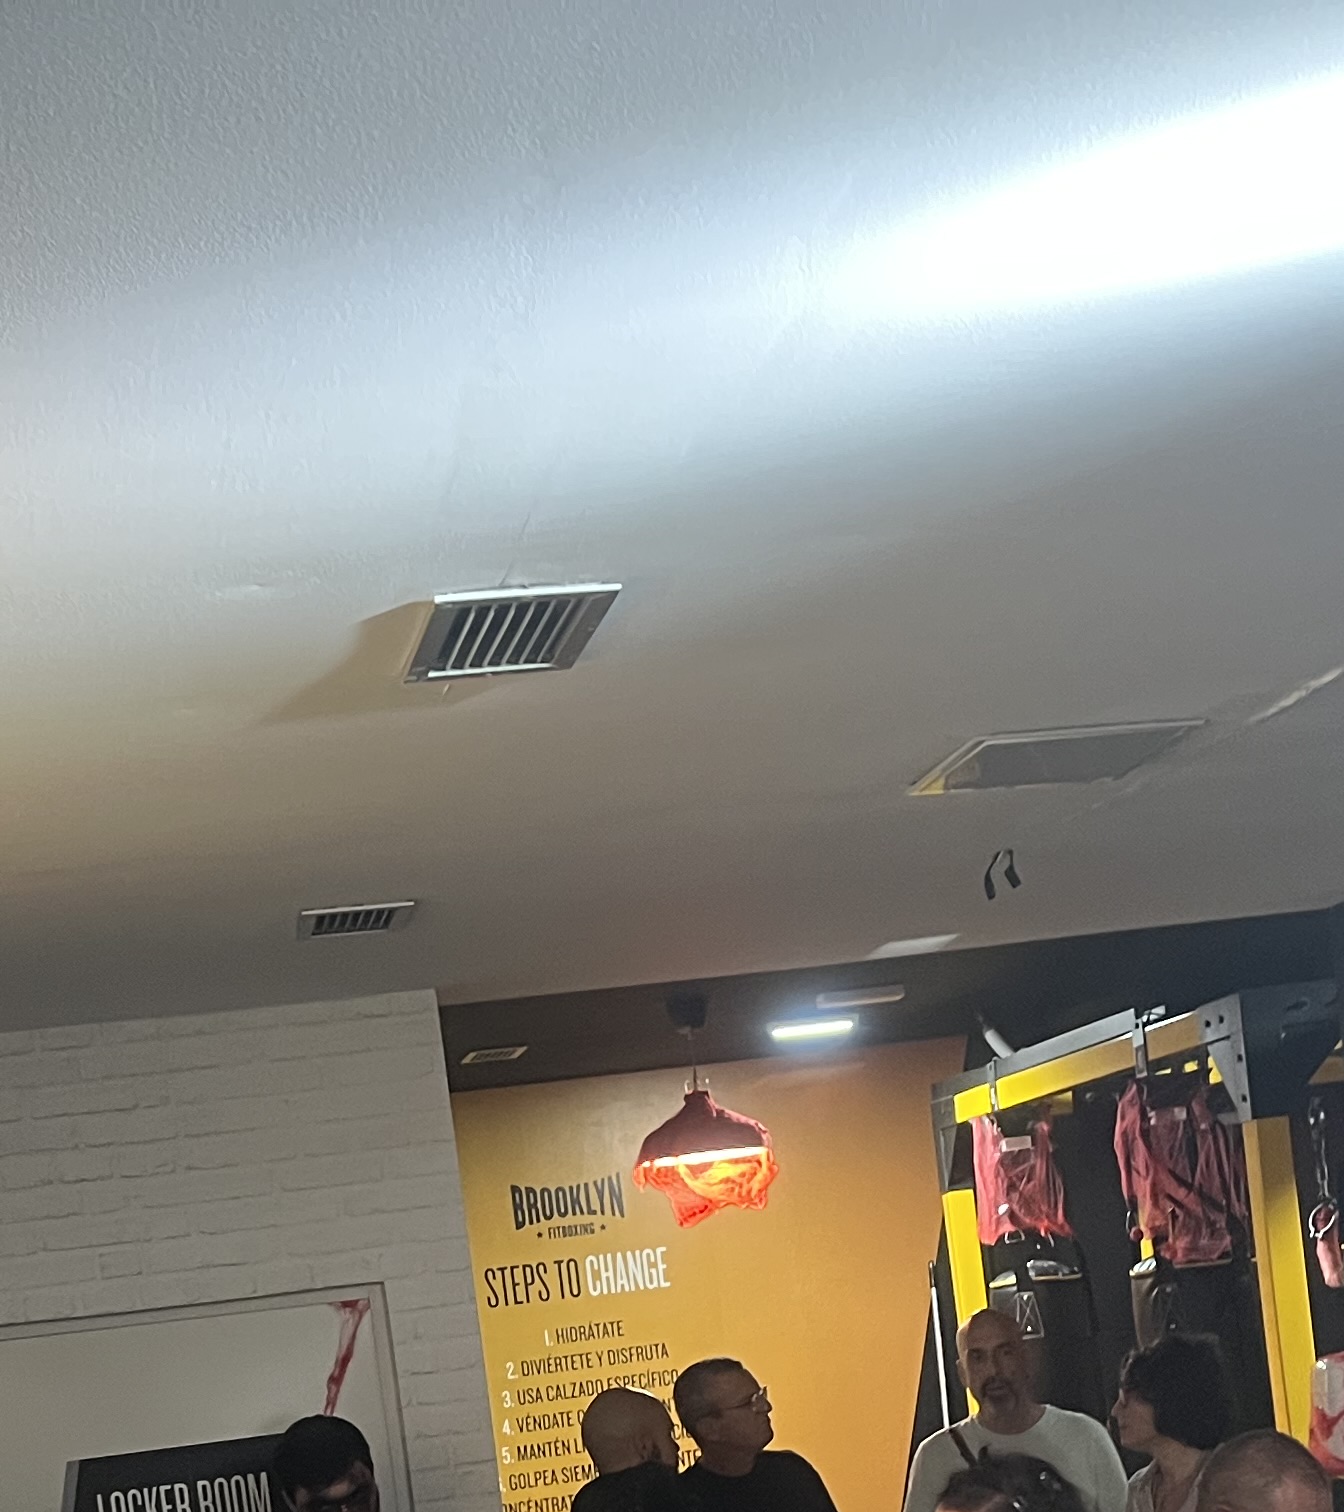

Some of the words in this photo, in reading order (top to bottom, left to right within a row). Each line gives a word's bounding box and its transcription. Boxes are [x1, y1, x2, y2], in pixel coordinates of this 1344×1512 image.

[510, 1172, 625, 1230] BROOKLYN
[548, 1222, 595, 1239] FITBOXING
[484, 1262, 551, 1308] STEPS
[553, 1258, 582, 1299] TO
[585, 1246, 671, 1297] CHANGE
[555, 1320, 625, 1345] HIDRÁTATE
[506, 1361, 519, 1380] 2.
[520, 1351, 594, 1377] DIVIÉRTETE
[595, 1351, 605, 1368] Y
[607, 1342, 670, 1367] DISFRUTA
[501, 1391, 515, 1408] 3.
[517, 1387, 544, 1406] USA
[546, 1378, 604, 1402] CALZADO
[502, 1419, 515, 1436] 4.
[516, 1411, 574, 1434] VÉNDATE
[502, 1446, 515, 1465] 5.
[517, 1437, 572, 1462] MANTÉN
[509, 1469, 560, 1491] GOLPEA
[561, 1464, 595, 1484] SIEM
